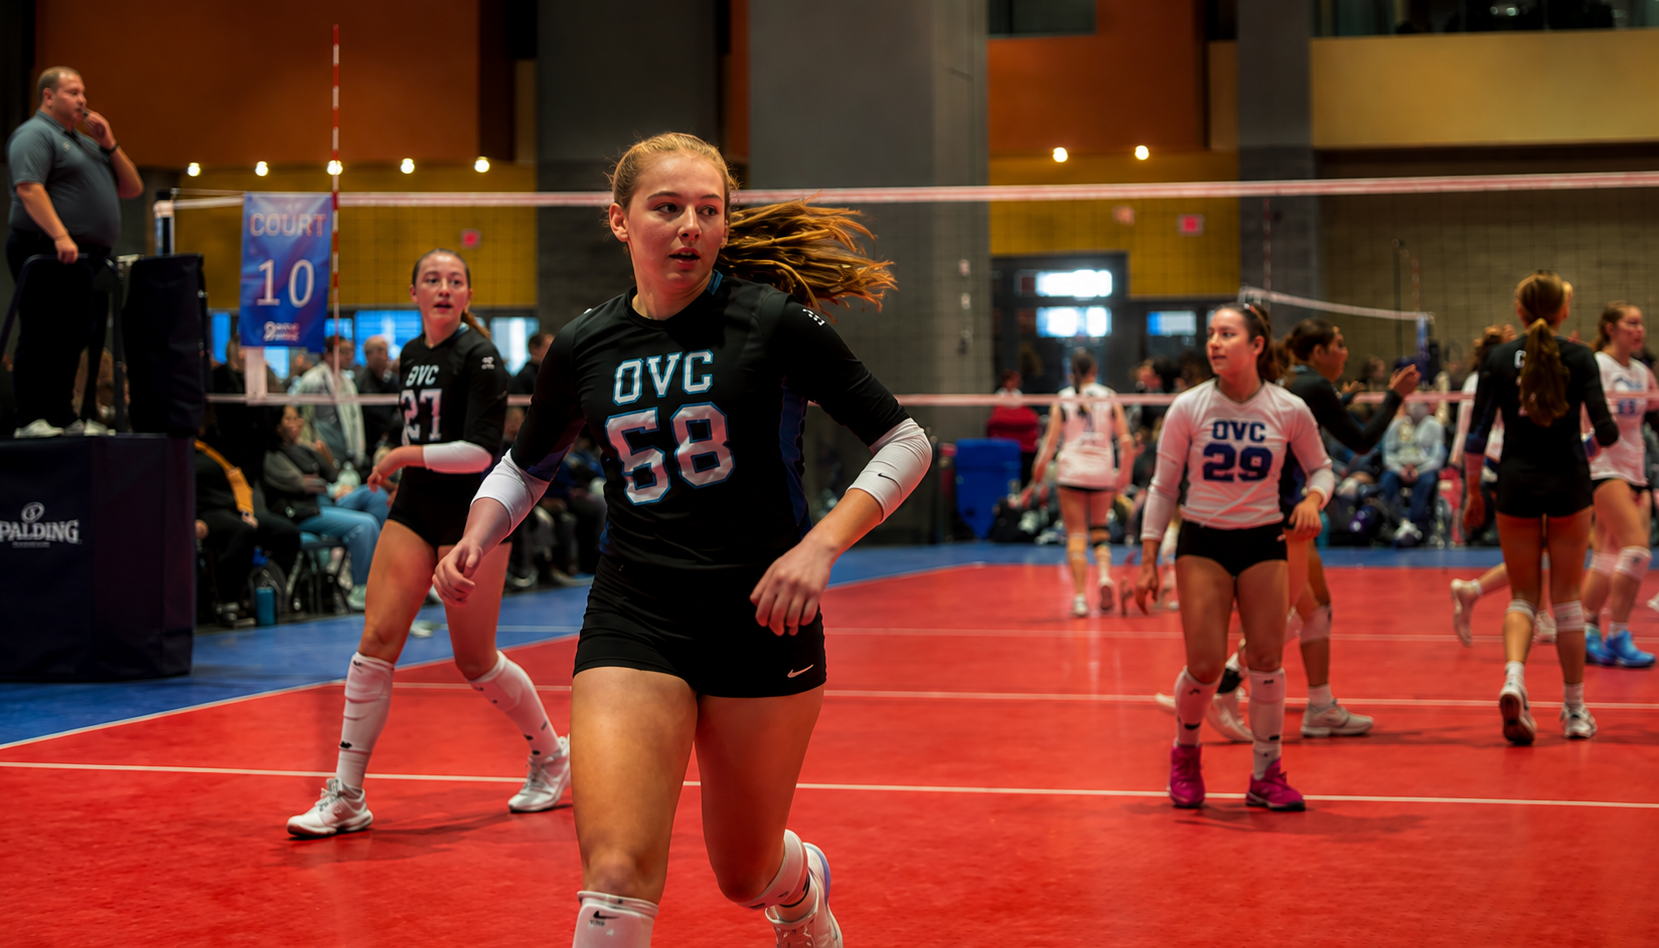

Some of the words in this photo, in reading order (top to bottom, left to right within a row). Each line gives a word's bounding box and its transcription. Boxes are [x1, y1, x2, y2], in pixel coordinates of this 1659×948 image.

[250, 213, 327, 236] COURT
[256, 259, 315, 308] 10
[612, 349, 713, 406] OVC
[401, 388, 442, 441] 27
[1212, 419, 1266, 443] OVC
[604, 402, 736, 506] 68
[1203, 441, 1273, 483] 29
[0, 519, 80, 544] PALDING
